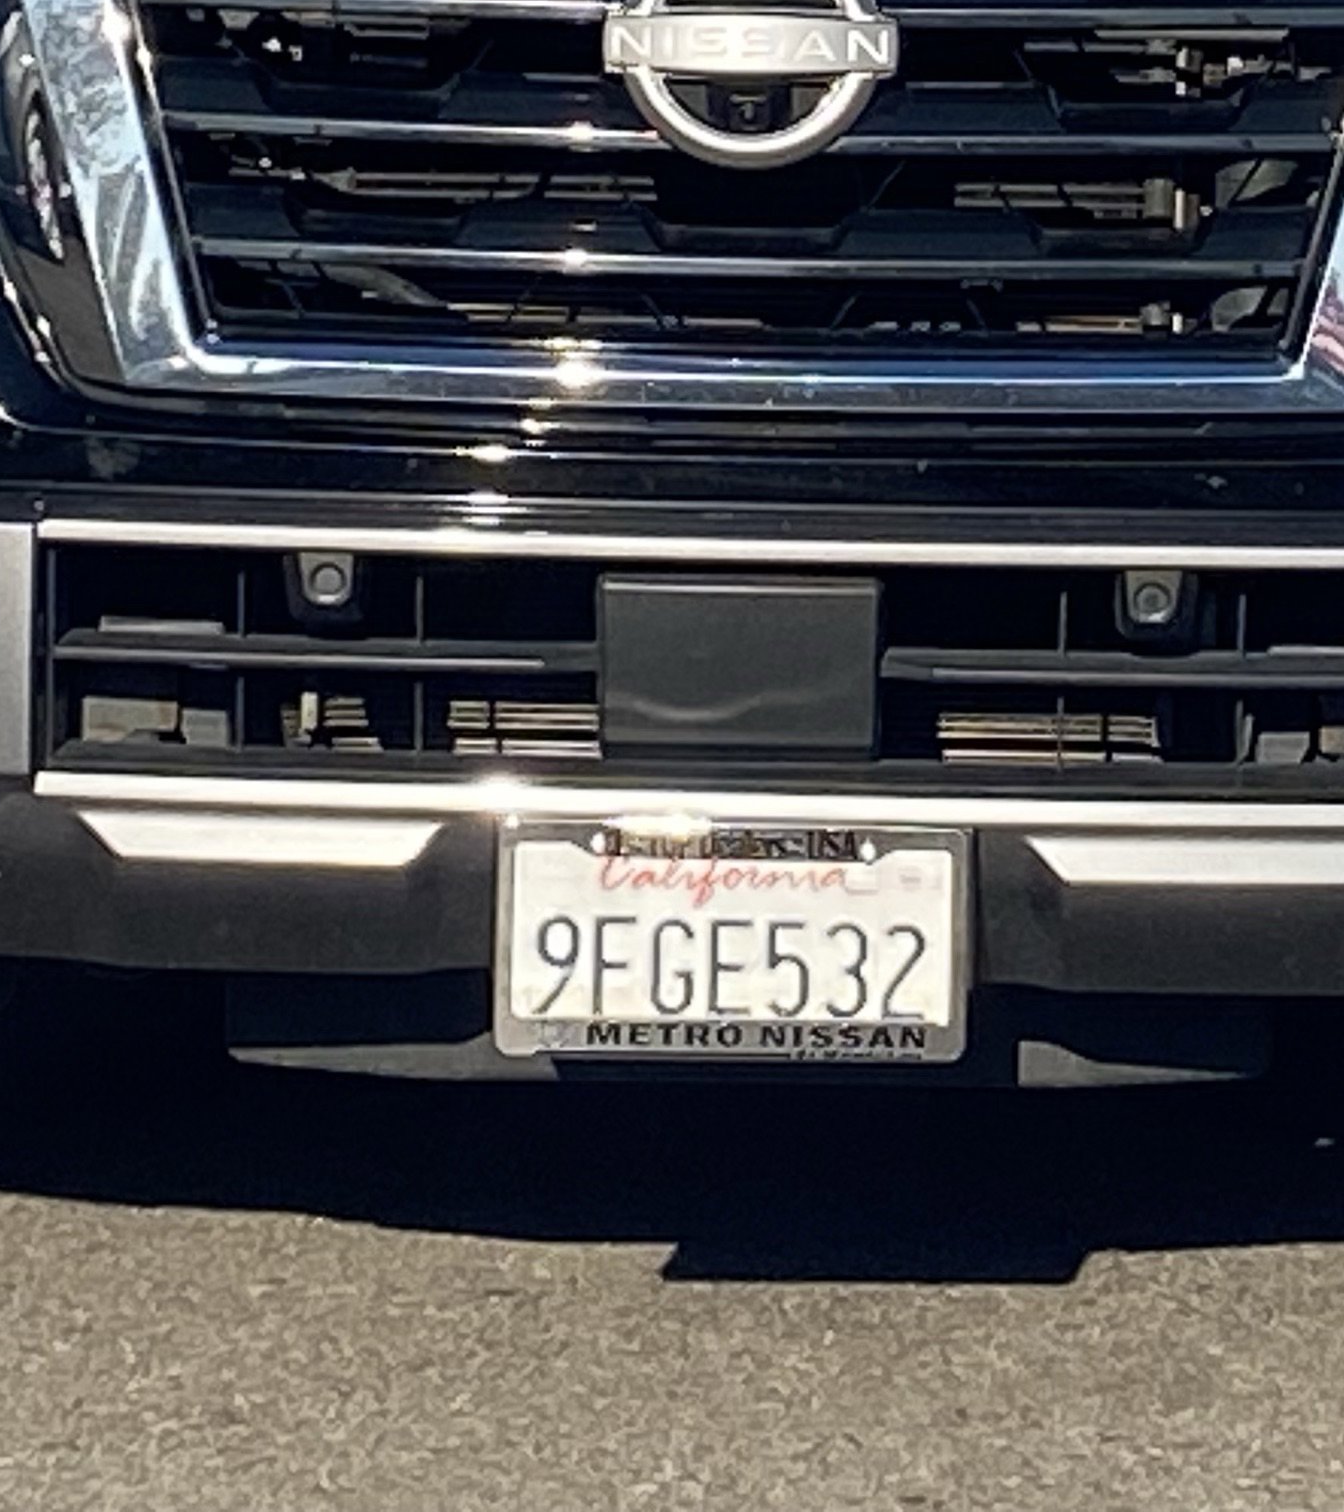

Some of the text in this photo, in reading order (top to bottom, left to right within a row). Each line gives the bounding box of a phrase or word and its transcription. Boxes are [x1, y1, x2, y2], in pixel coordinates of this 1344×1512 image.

[609, 25, 891, 65] NISSAN
[599, 855, 848, 907] California
[532, 915, 926, 1021] 9FGE532
[586, 1021, 927, 1050] METRO NISSAN
